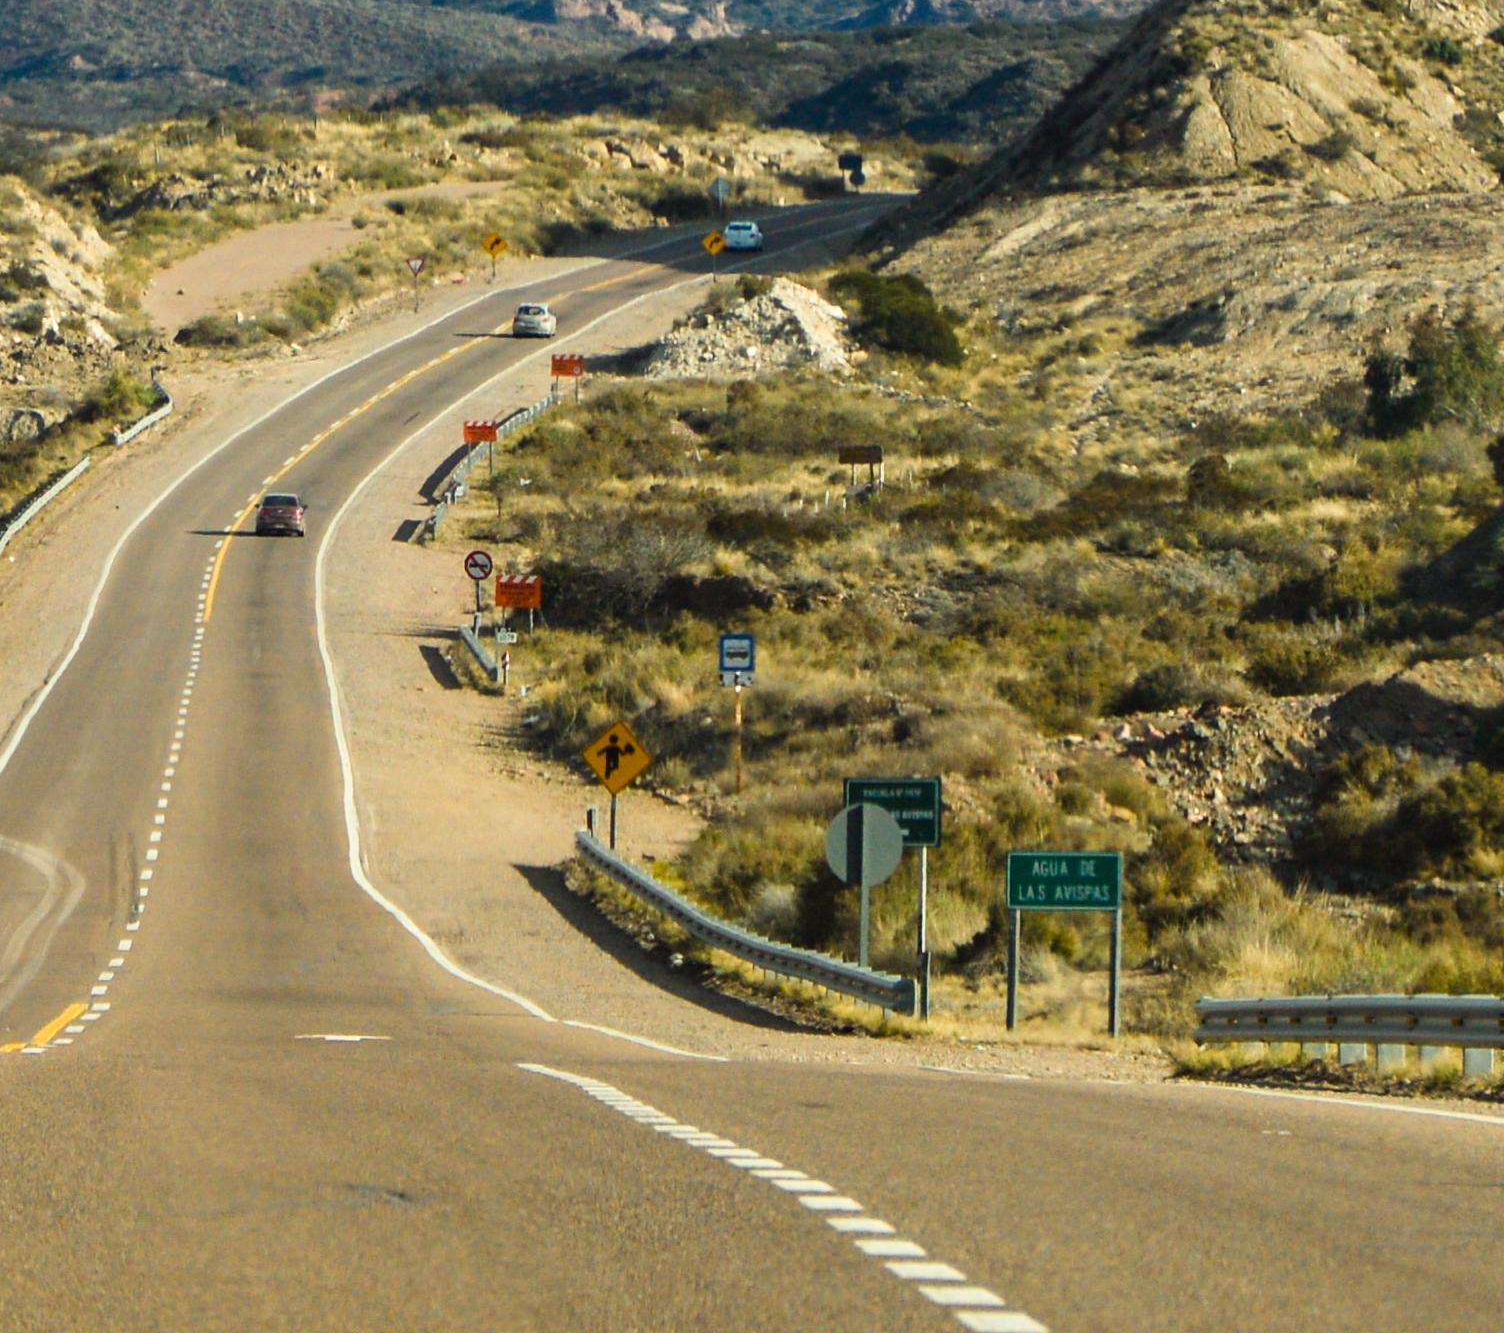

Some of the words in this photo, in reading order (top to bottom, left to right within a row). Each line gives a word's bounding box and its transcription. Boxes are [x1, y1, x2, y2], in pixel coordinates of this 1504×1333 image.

[1032, 859, 1069, 877] AGUA
[1080, 859, 1097, 877] DE
[1018, 885, 1046, 901] LAS
[1055, 885, 1110, 901] AVISPAS
